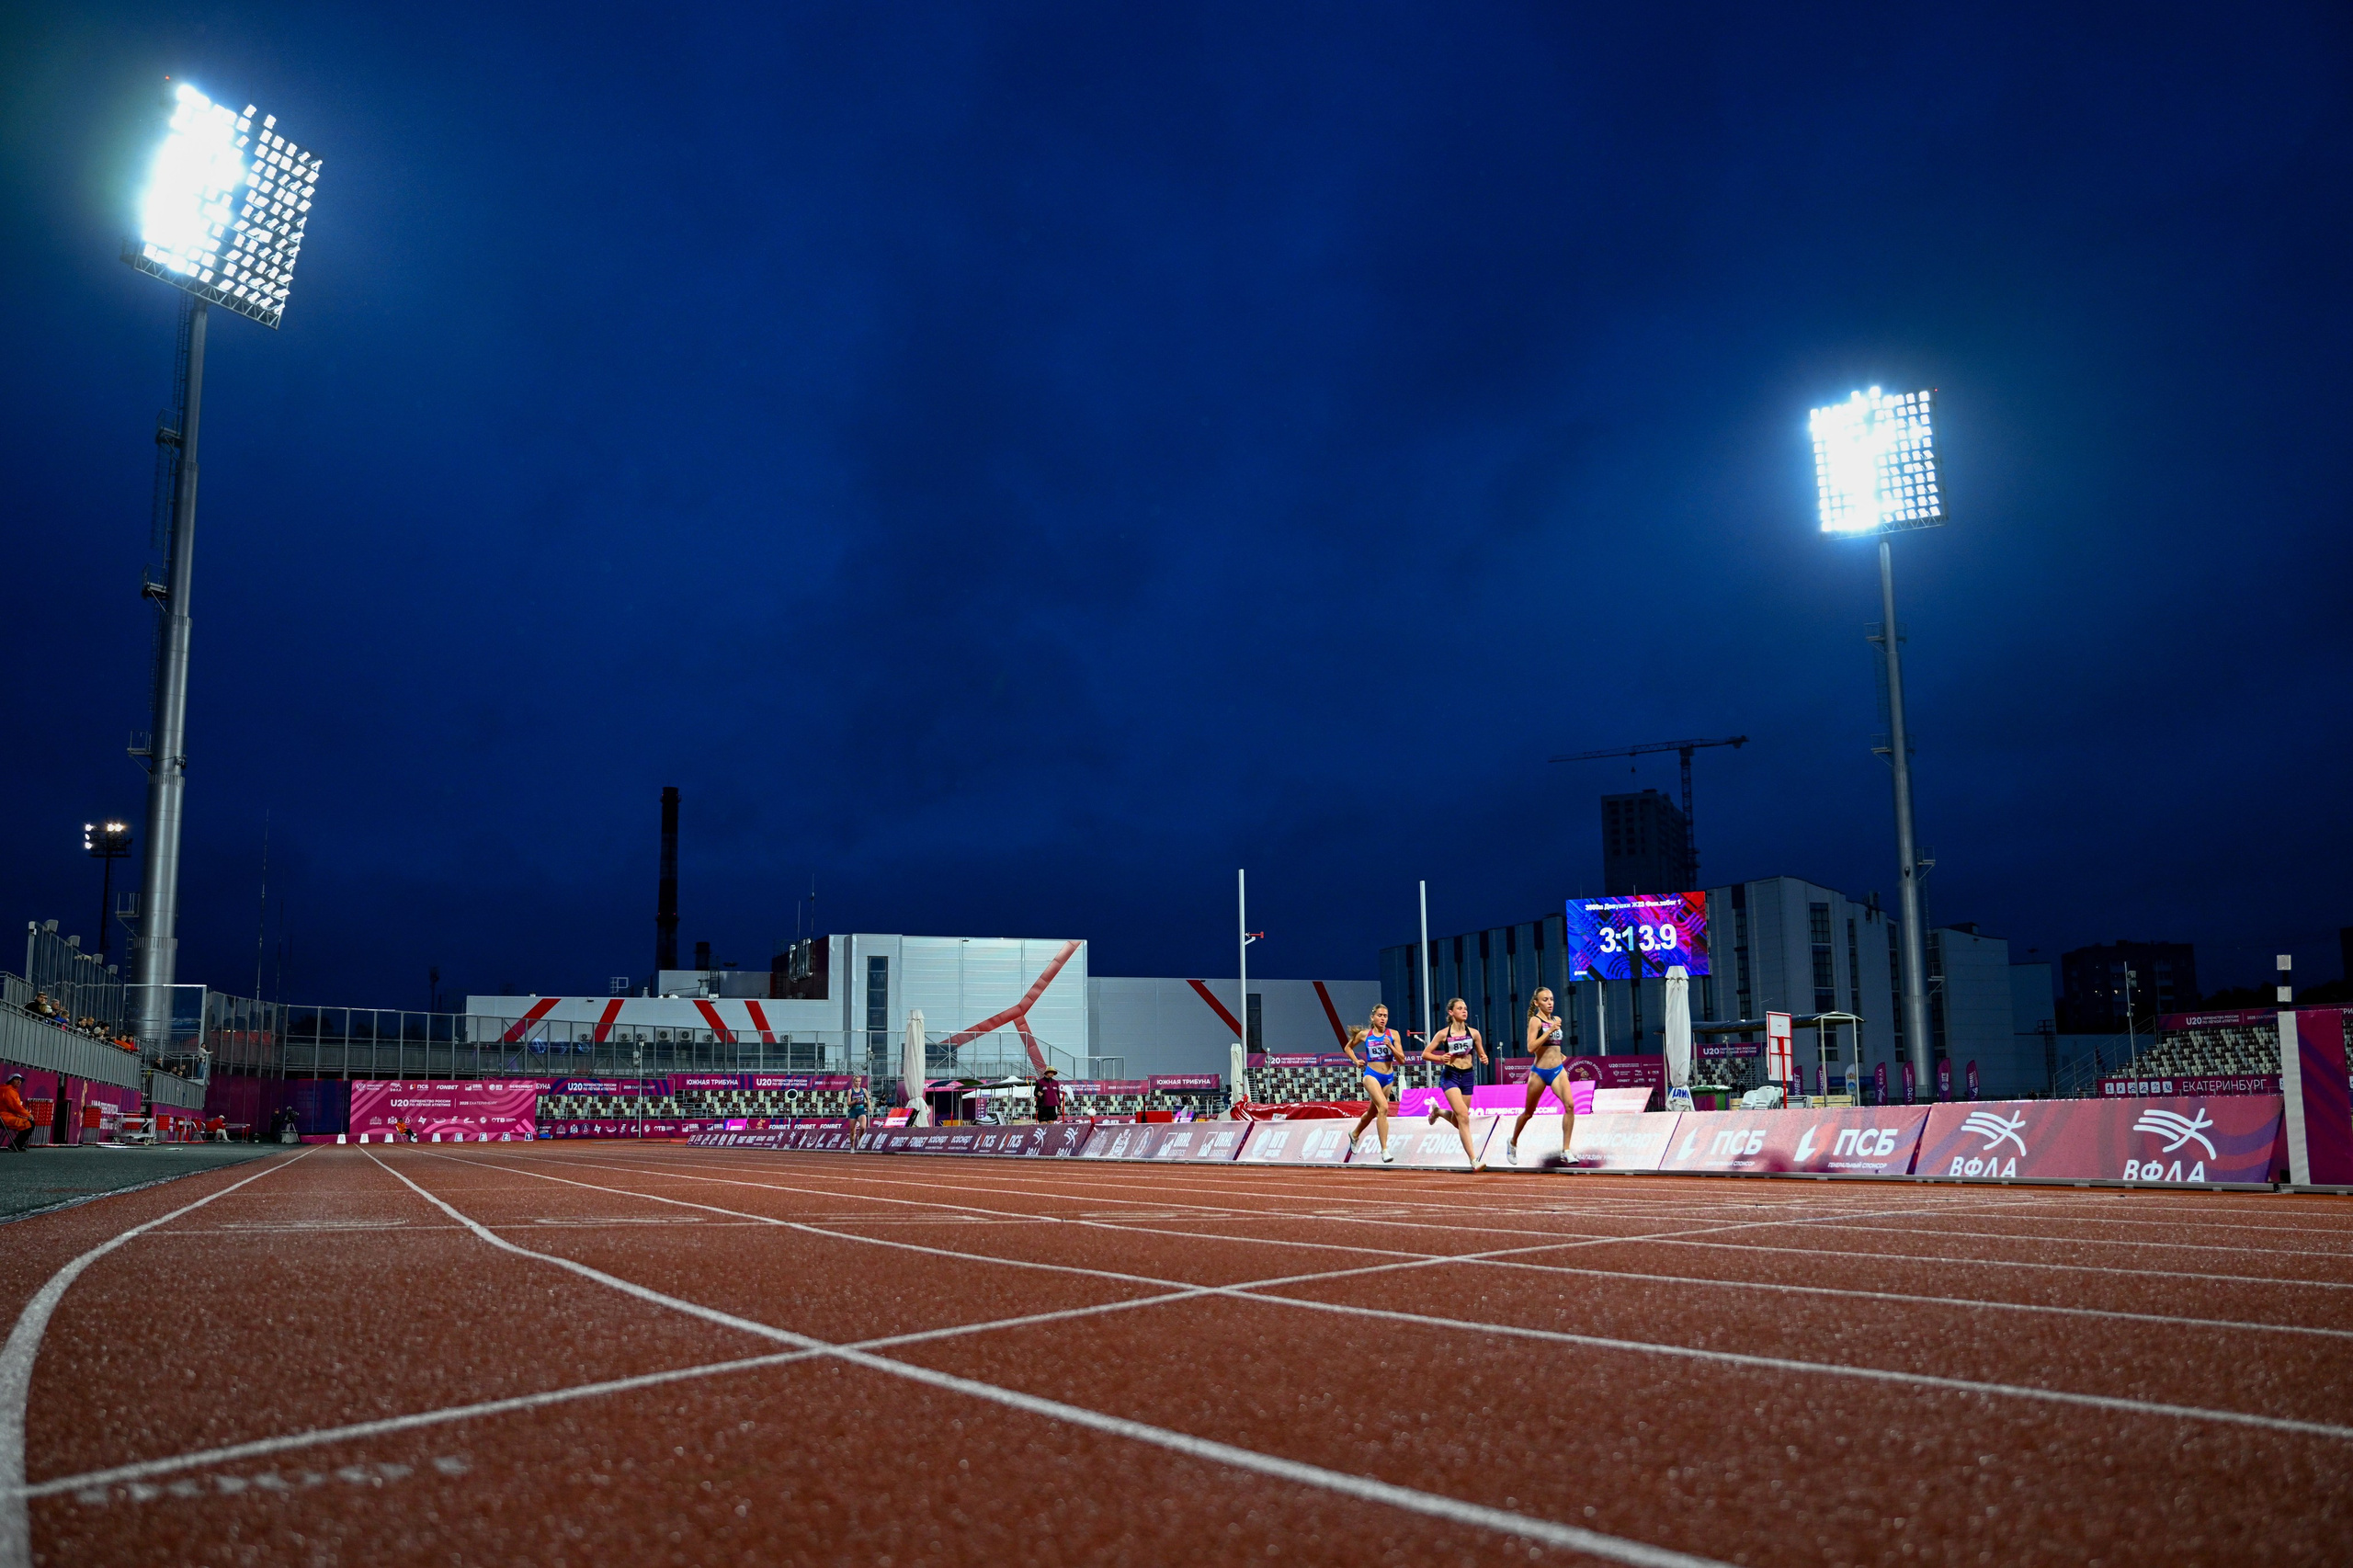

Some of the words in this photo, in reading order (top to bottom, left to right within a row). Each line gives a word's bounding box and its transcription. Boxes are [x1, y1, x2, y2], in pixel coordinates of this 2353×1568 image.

[1599, 923, 1677, 953] 3:13.9
[2186, 1017, 2202, 1026] U20
[1371, 1047, 1389, 1055] 830
[1453, 1042, 1469, 1051] 815
[1568, 1060, 1593, 1073] ПЕРВЕНСТВО
[1592, 1063, 1603, 1080] РОССИИ
[567, 1083, 583, 1091] U20
[756, 1078, 772, 1086] U20
[2182, 1079, 2268, 1092] ЕКАТЕРИНБУРГ
[981, 1134, 996, 1148] ПСБ
[1007, 1134, 1024, 1148] ПСБ
[1173, 1131, 1193, 1147] URAL
[1213, 1131, 1235, 1147] URAL
[1711, 1130, 1766, 1155] ПСБ
[1834, 1129, 1899, 1156] ПСБ
[1949, 1156, 2017, 1177] ВФЛА
[2122, 1159, 2206, 1183] ВФЛА
